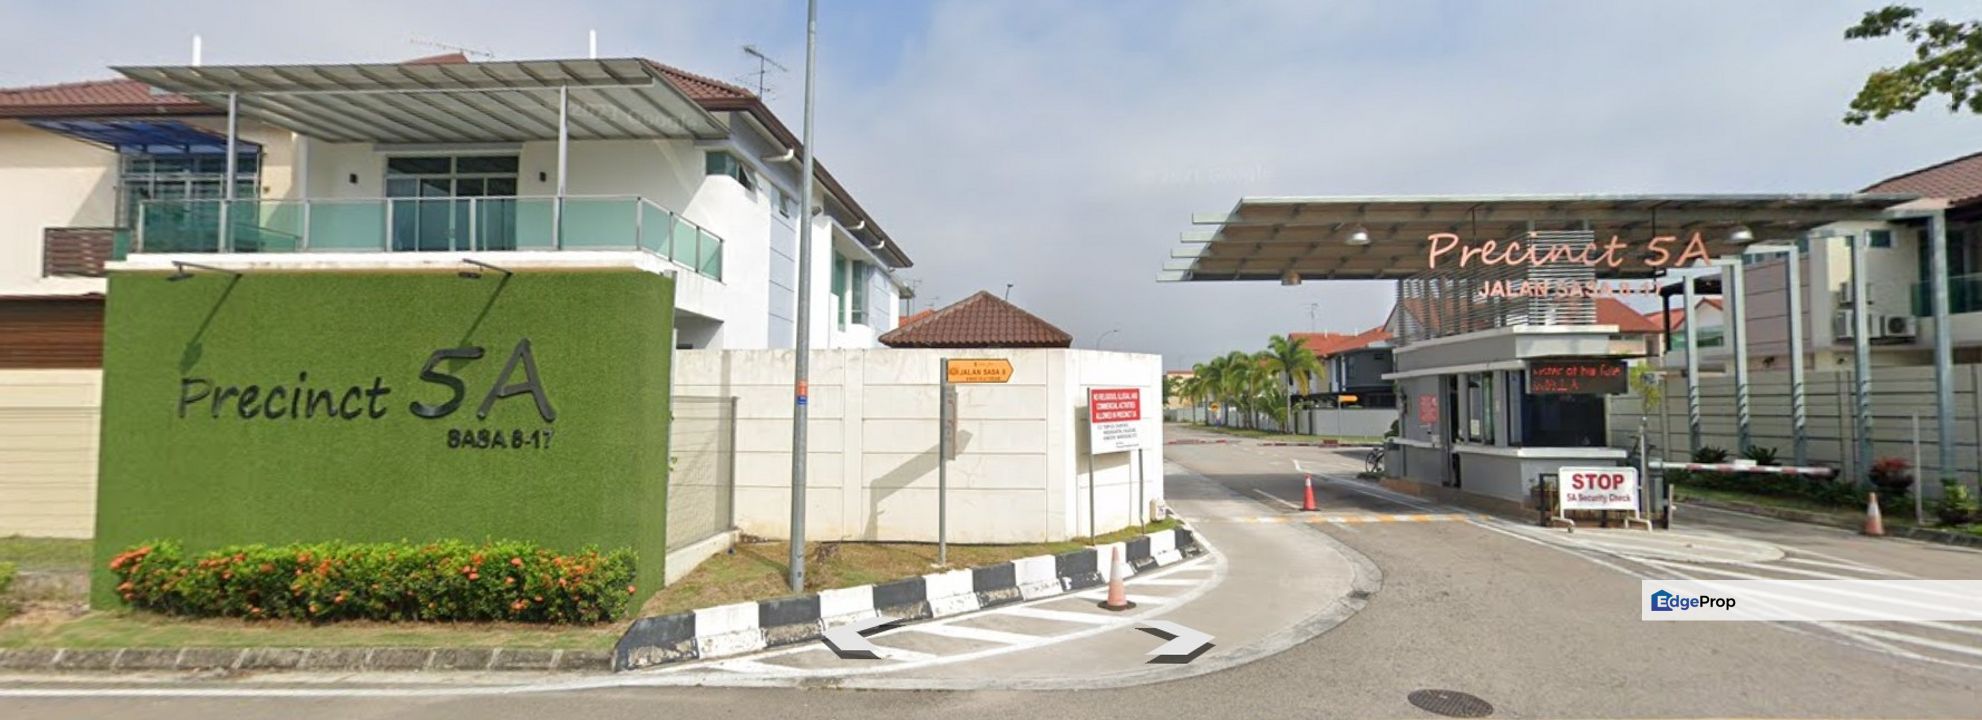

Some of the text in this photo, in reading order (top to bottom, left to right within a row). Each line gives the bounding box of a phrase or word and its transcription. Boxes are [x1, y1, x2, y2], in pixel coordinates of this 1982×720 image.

[1427, 231, 1714, 269] Precinct 5A
[1478, 279, 1549, 298] JALAN
[1555, 280, 1613, 299] SASA
[176, 337, 557, 423] Precinct 5A
[447, 428, 554, 449] SASA 8-17
[1572, 473, 1624, 490] STOP
[1578, 493, 1606, 504] Security
[1608, 493, 1631, 502] Check
